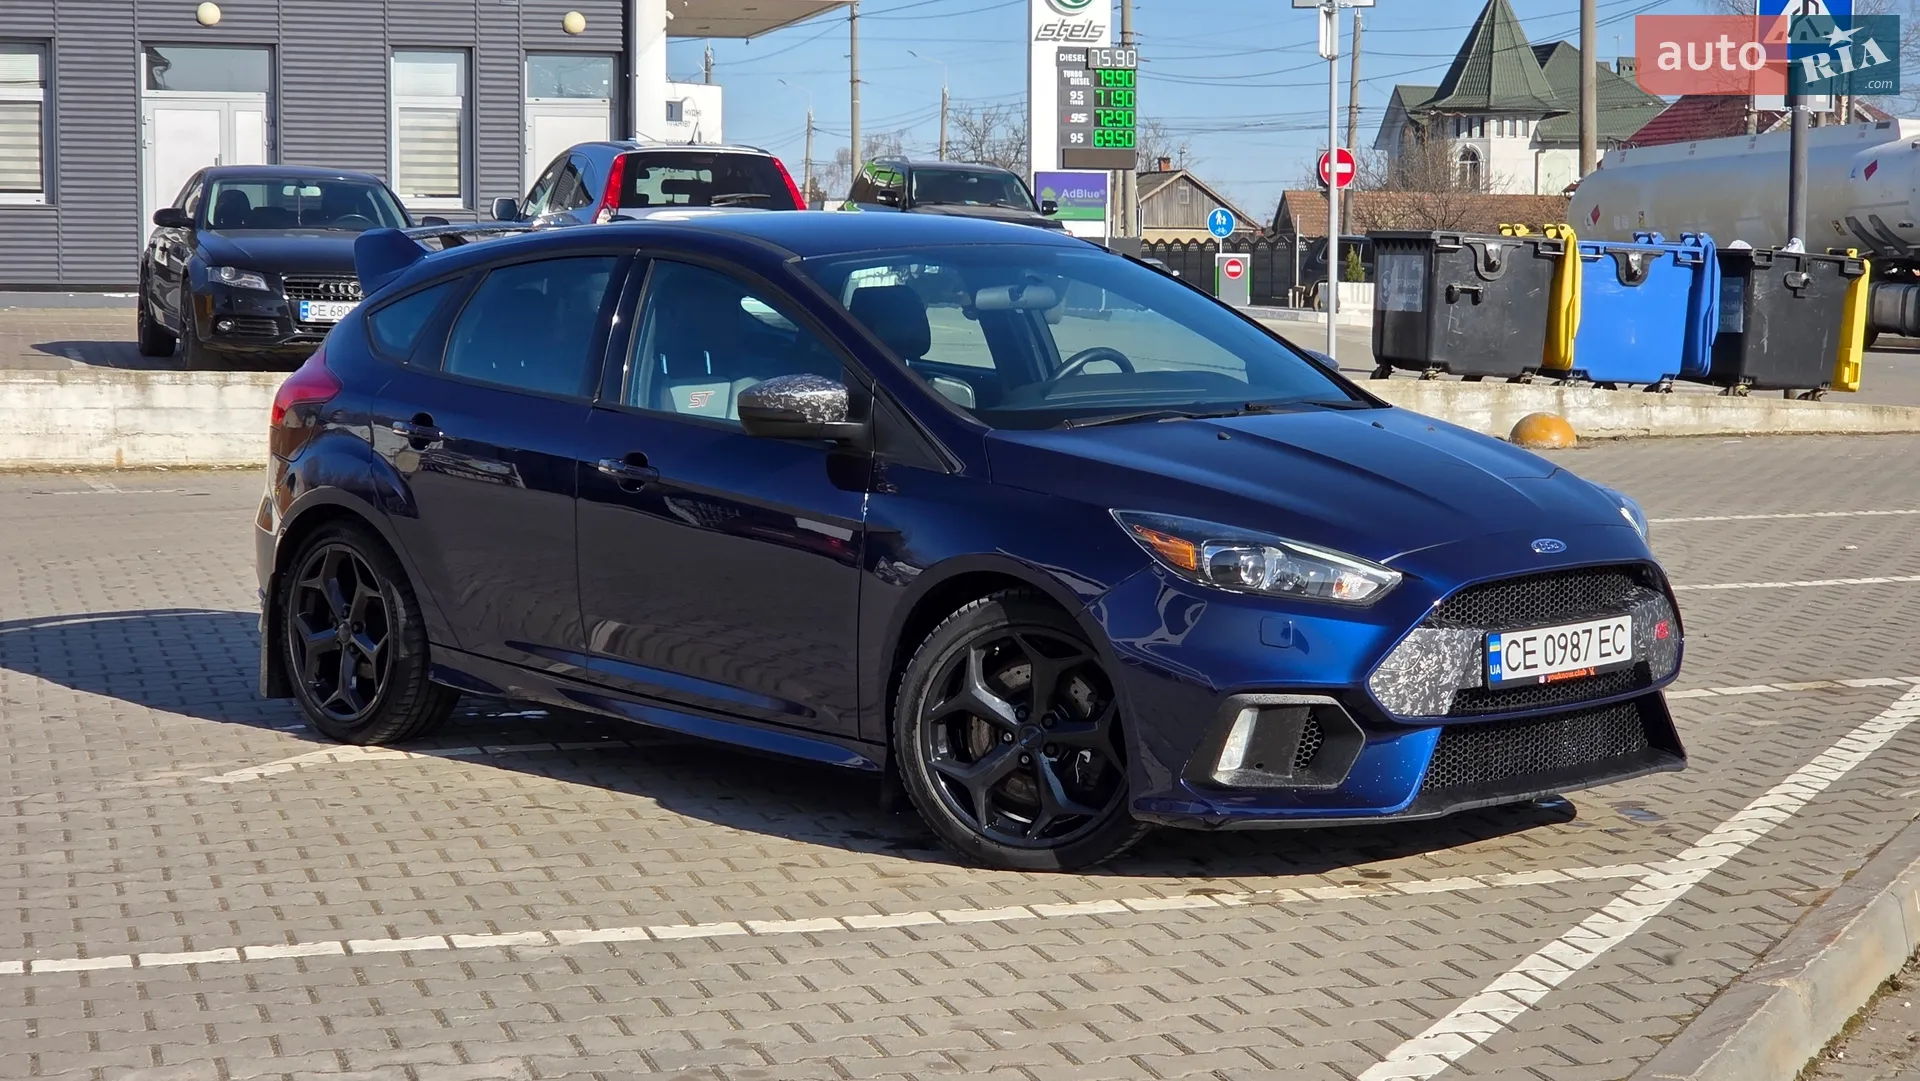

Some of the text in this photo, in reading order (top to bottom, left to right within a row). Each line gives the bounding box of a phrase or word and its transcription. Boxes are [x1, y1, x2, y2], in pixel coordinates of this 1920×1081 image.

[1035, 18, 1106, 42] stels
[1059, 53, 1087, 62] DIESEL
[1091, 49, 1137, 67] 75.90
[1063, 70, 1083, 78] TURBO
[1070, 77, 1091, 86] DIESEL
[1095, 69, 1135, 87] 79.90
[1069, 90, 1084, 100] 95
[1095, 110, 1135, 127] 72.90
[1069, 132, 1084, 144] 95
[1094, 130, 1135, 147] 69.50
[309, 304, 355, 317] CE 680
[687, 390, 715, 408] ST
[1505, 623, 1625, 672] CE 0987 EC
[1489, 664, 1502, 675] UA
